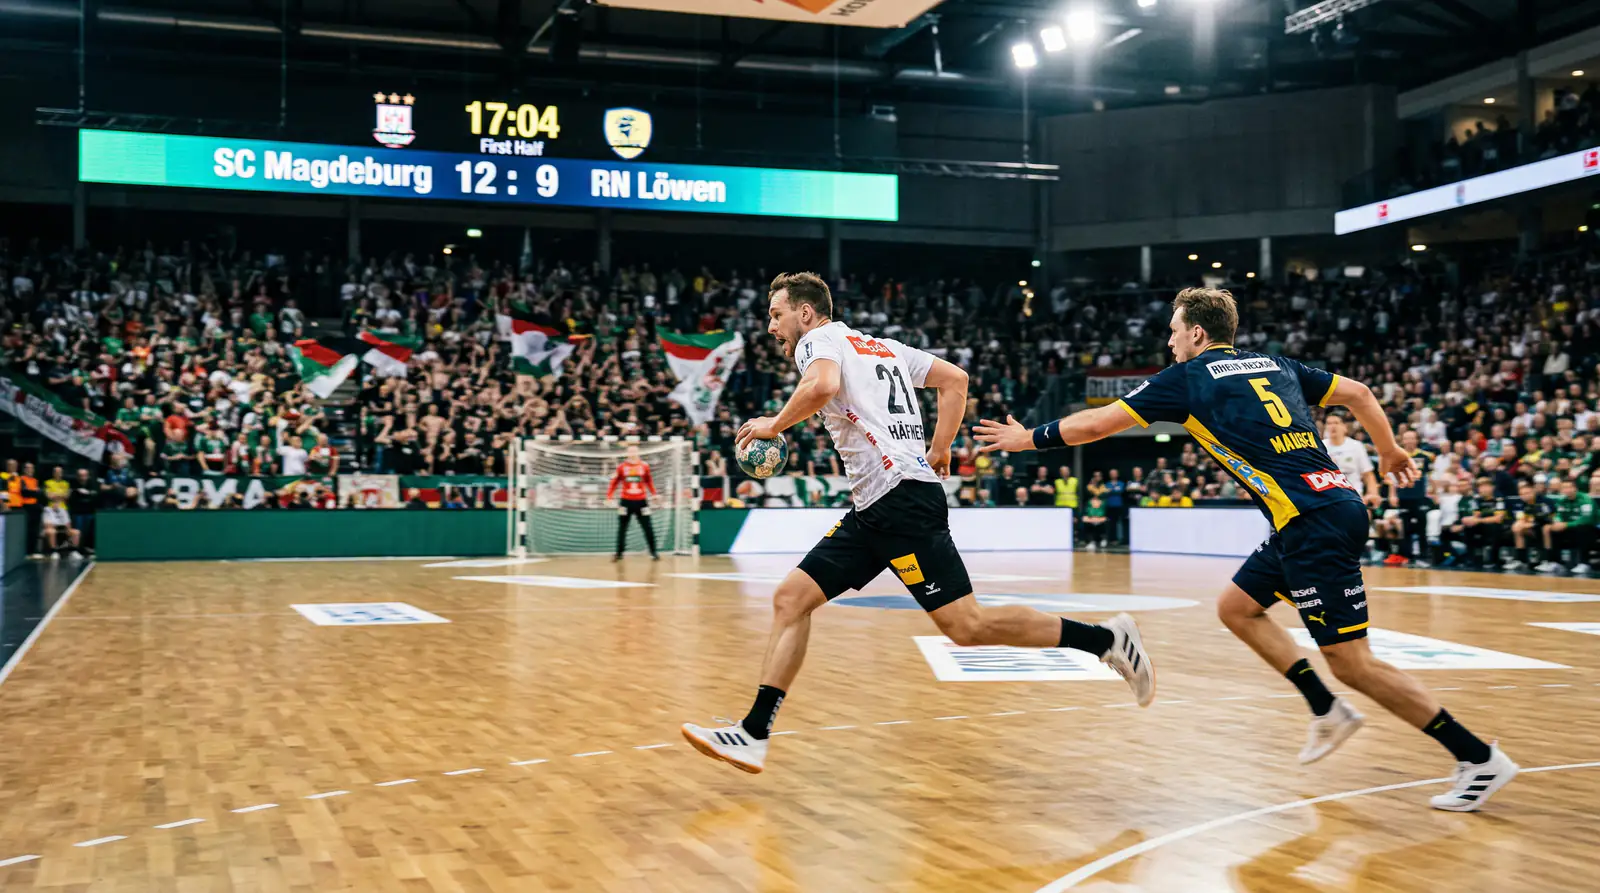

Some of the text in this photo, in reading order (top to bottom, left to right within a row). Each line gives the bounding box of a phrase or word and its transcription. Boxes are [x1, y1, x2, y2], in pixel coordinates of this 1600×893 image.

[465, 100, 560, 138] 17:04
[480, 138, 544, 156] First Half
[213, 147, 433, 194] SC Magdeburg
[455, 160, 497, 194] 12
[535, 164, 559, 197] 9
[590, 168, 726, 203] RN Löwen
[875, 363, 916, 415] 21
[1248, 377, 1292, 428] 5
